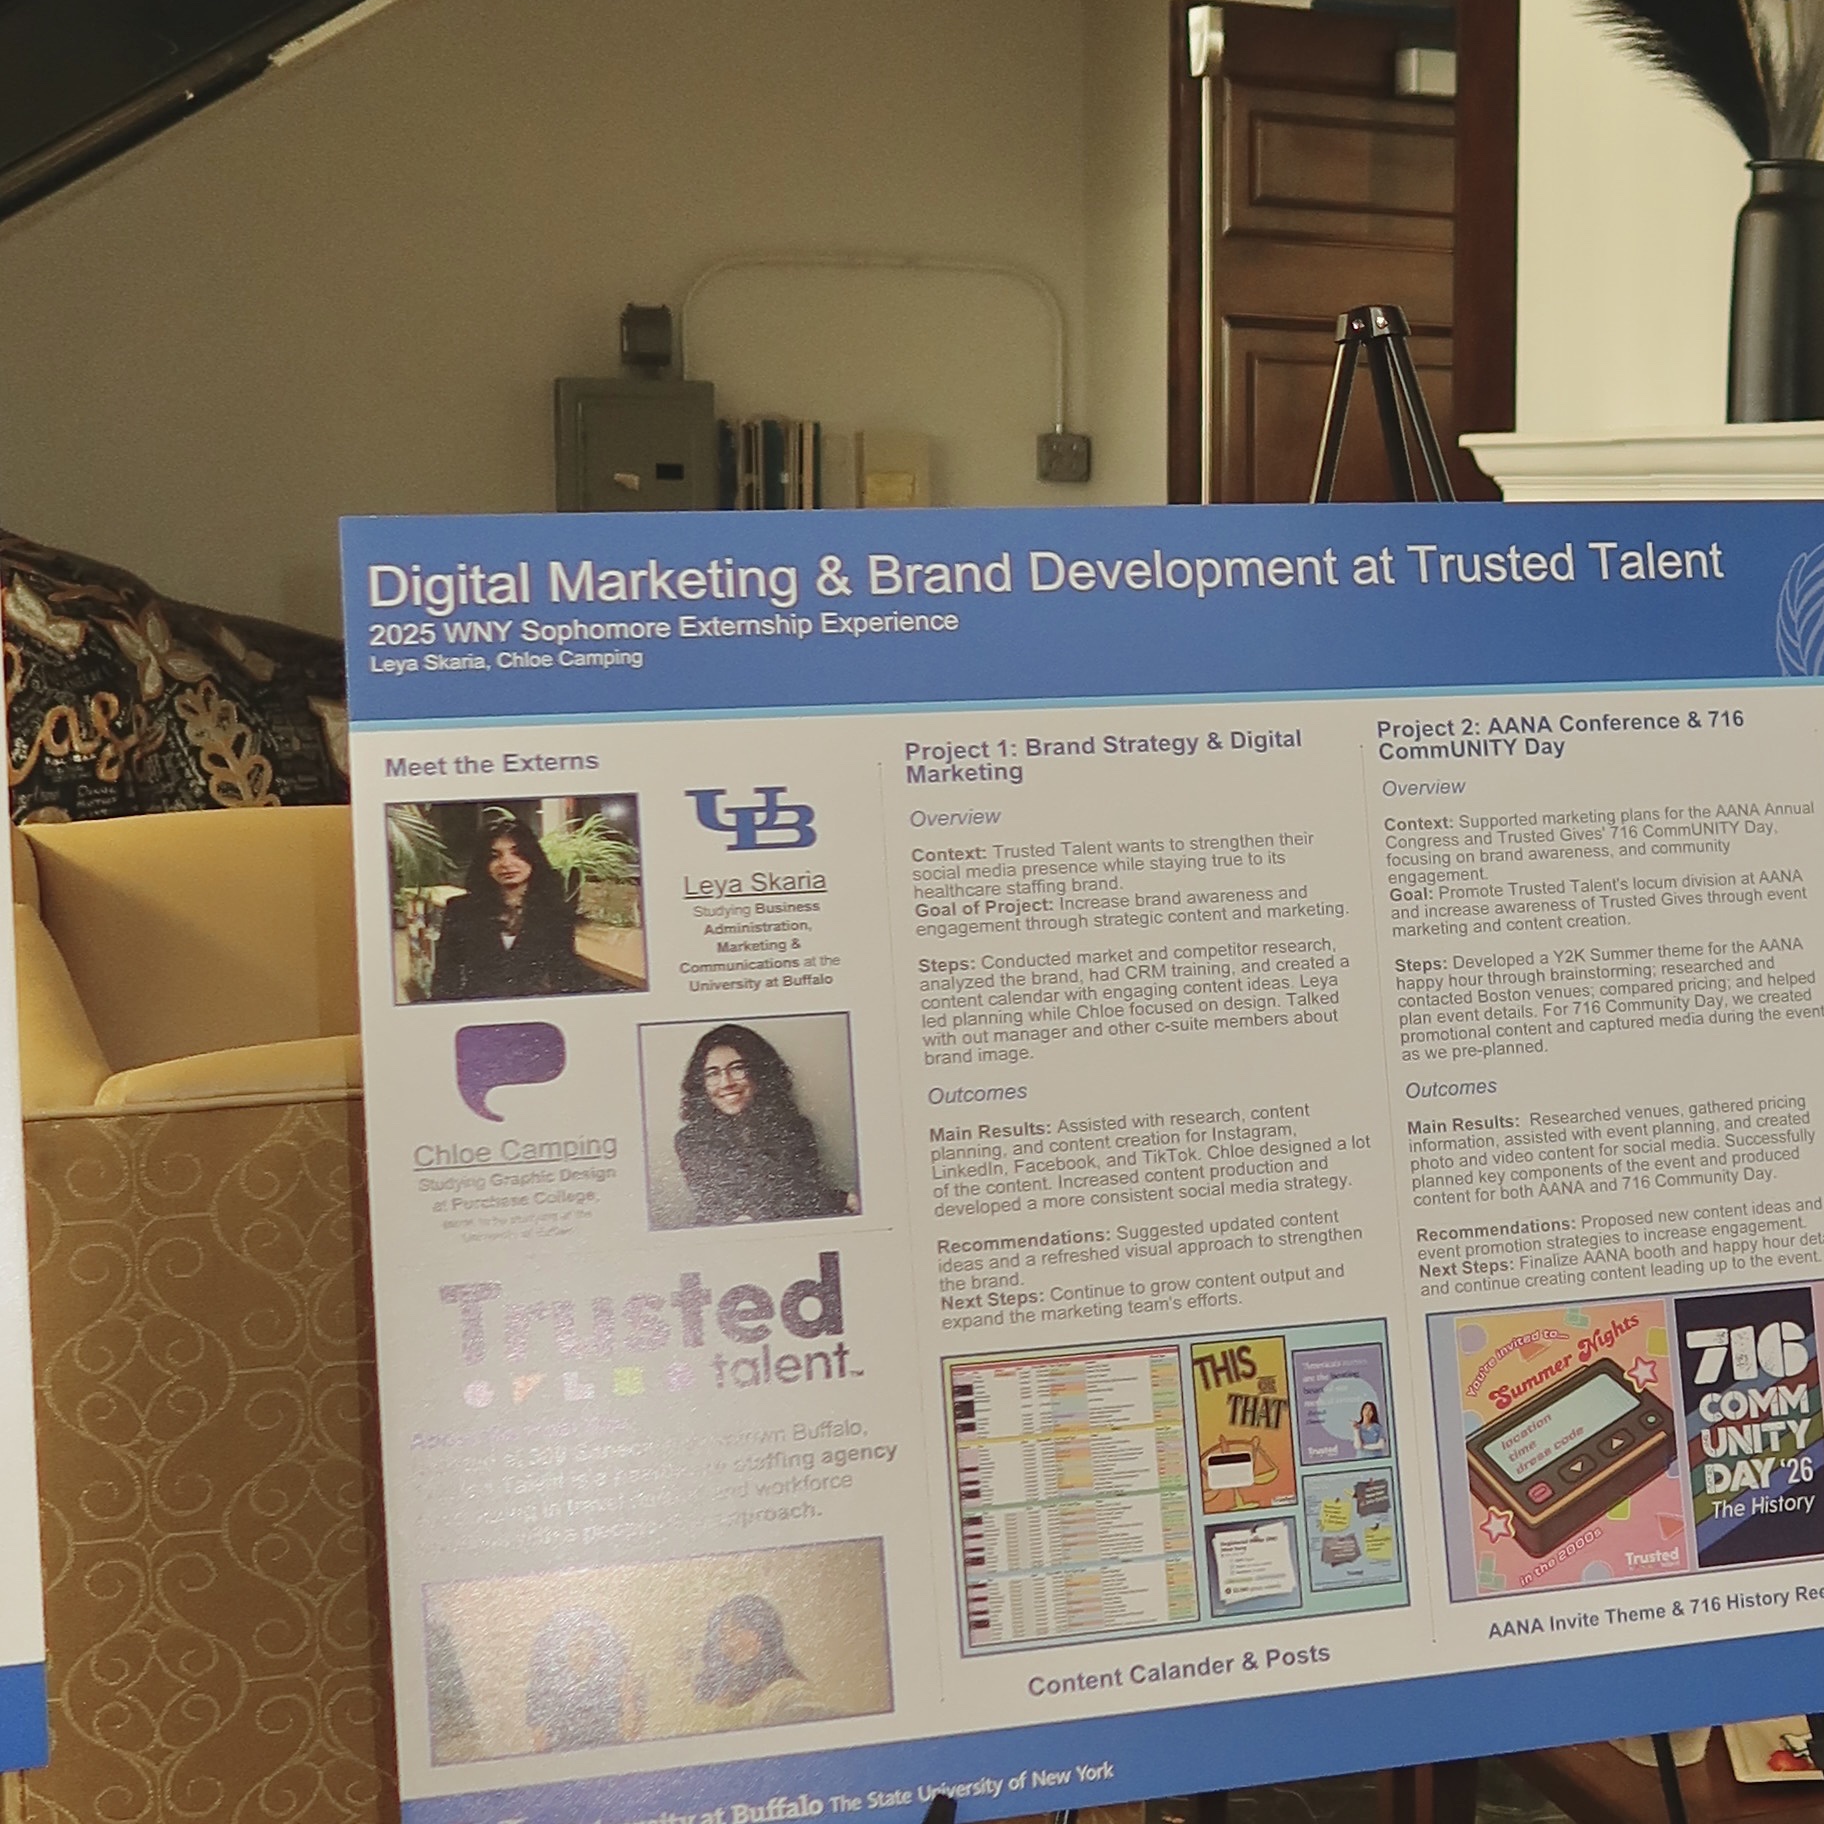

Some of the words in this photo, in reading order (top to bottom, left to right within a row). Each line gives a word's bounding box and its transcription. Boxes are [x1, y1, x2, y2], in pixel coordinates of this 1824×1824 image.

[368, 561, 530, 618] Digital
[549, 557, 798, 610] Marketing
[816, 554, 853, 597] &
[868, 551, 1012, 597] Brand
[1029, 547, 1340, 600] Development
[1352, 546, 1396, 586] at
[1406, 541, 1575, 584] Trusted
[1587, 539, 1725, 581] Talent
[368, 622, 437, 648] 2025
[442, 618, 514, 645] WNY
[520, 617, 672, 648] Sophomore
[678, 611, 813, 640] Externship
[819, 610, 960, 638] Experience
[370, 655, 419, 676] Leya
[422, 651, 492, 672] Skaria,
[495, 650, 554, 670] Chloe
[557, 648, 644, 670] Camping
[1376, 719, 1456, 741] Project
[1460, 717, 1481, 736] 2:
[1487, 715, 1553, 736] AANA
[1558, 713, 1680, 733] Conference
[1686, 710, 1703, 729] &
[1707, 709, 1745, 728] 716
[904, 740, 991, 764] Project
[996, 738, 1017, 758] 1:
[1025, 735, 1096, 757] Brand
[1102, 734, 1199, 757] Strategy
[1206, 731, 1224, 751] &
[1230, 728, 1302, 755] Digital
[1378, 737, 1518, 761] CommUNITY
[1524, 737, 1566, 759] Day
[384, 757, 448, 778] Meet
[452, 754, 495, 775] the
[502, 752, 600, 773] Externs
[906, 765, 1024, 785] Marketing
[1382, 779, 1466, 797] Overview
[684, 785, 818, 851] UB
[910, 808, 1001, 827] Overview
[684, 875, 743, 898] Leya
[751, 871, 826, 892] Skaria
[692, 904, 752, 919] Studying
[754, 900, 821, 916] Business
[703, 919, 813, 936] Administration,
[716, 936, 788, 955] Marketing
[790, 937, 802, 952] &
[917, 957, 976, 975] Steps:
[980, 950, 1072, 972] Conducted
[1076, 948, 1134, 967] market
[1137, 945, 1169, 967] and
[1172, 941, 1259, 964] competitor
[1262, 936, 1336, 961] research,
[678, 956, 801, 975] Communications
[803, 956, 817, 969] at
[818, 954, 841, 967] the
[688, 977, 762, 993] University
[764, 976, 780, 988] at
[781, 972, 834, 989] Buffalo
[928, 1083, 1028, 1105] Outcomes
[1405, 1079, 1498, 1099] Outcomes
[415, 1141, 491, 1166] Chloe
[500, 1135, 617, 1162] Camping
[440, 1251, 844, 1366] Trusted
[1488, 1354, 1573, 1409] Summer
[1578, 1314, 1640, 1362] Nights
[1685, 1321, 1809, 1384] 716
[1193, 1345, 1257, 1392] THIS
[1227, 1392, 1288, 1429] THAT
[1699, 1384, 1809, 1423] COMM
[1501, 1413, 1552, 1450] location
[1701, 1417, 1811, 1458] UNITY
[1705, 1458, 1776, 1494] DAY
[1712, 1499, 1745, 1519] The
[1752, 1494, 1815, 1516] History
[1625, 1547, 1680, 1566] Trusted
[1519, 1575, 1533, 1587] in
[1534, 1559, 1556, 1577] the
[1488, 1617, 1545, 1640] AANA
[1549, 1612, 1600, 1632] Invite
[1603, 1606, 1666, 1625] Theme
[1671, 1600, 1685, 1617] &
[1689, 1595, 1722, 1615] 716
[1726, 1591, 1790, 1610] History
[1027, 1667, 1124, 1697] Content
[1129, 1655, 1235, 1685] Calander
[1241, 1651, 1260, 1672] &
[1265, 1644, 1331, 1669] Posts
[827, 1794, 863, 1813] The
[866, 1789, 913, 1809] State
[1007, 1769, 1028, 1791] of
[1031, 1769, 1072, 1789] New
[1075, 1760, 1115, 1783] York
